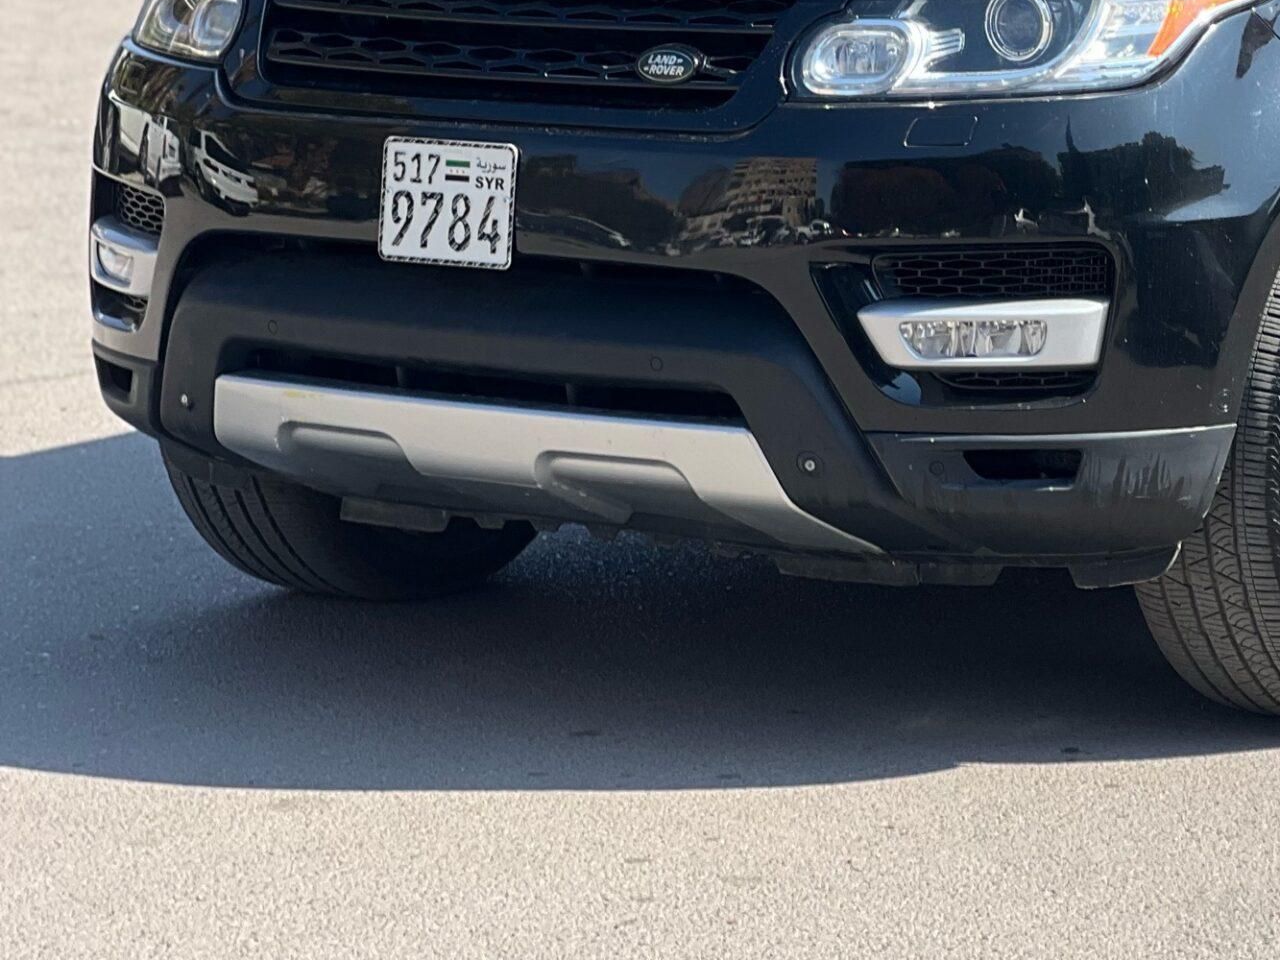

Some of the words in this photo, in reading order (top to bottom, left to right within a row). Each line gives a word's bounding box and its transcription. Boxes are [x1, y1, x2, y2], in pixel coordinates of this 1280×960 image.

[648, 64, 684, 76] ROVER
[393, 151, 441, 185] 517
[476, 157, 506, 174] سورية
[475, 176, 505, 191] SYR
[391, 189, 501, 254] 9784
